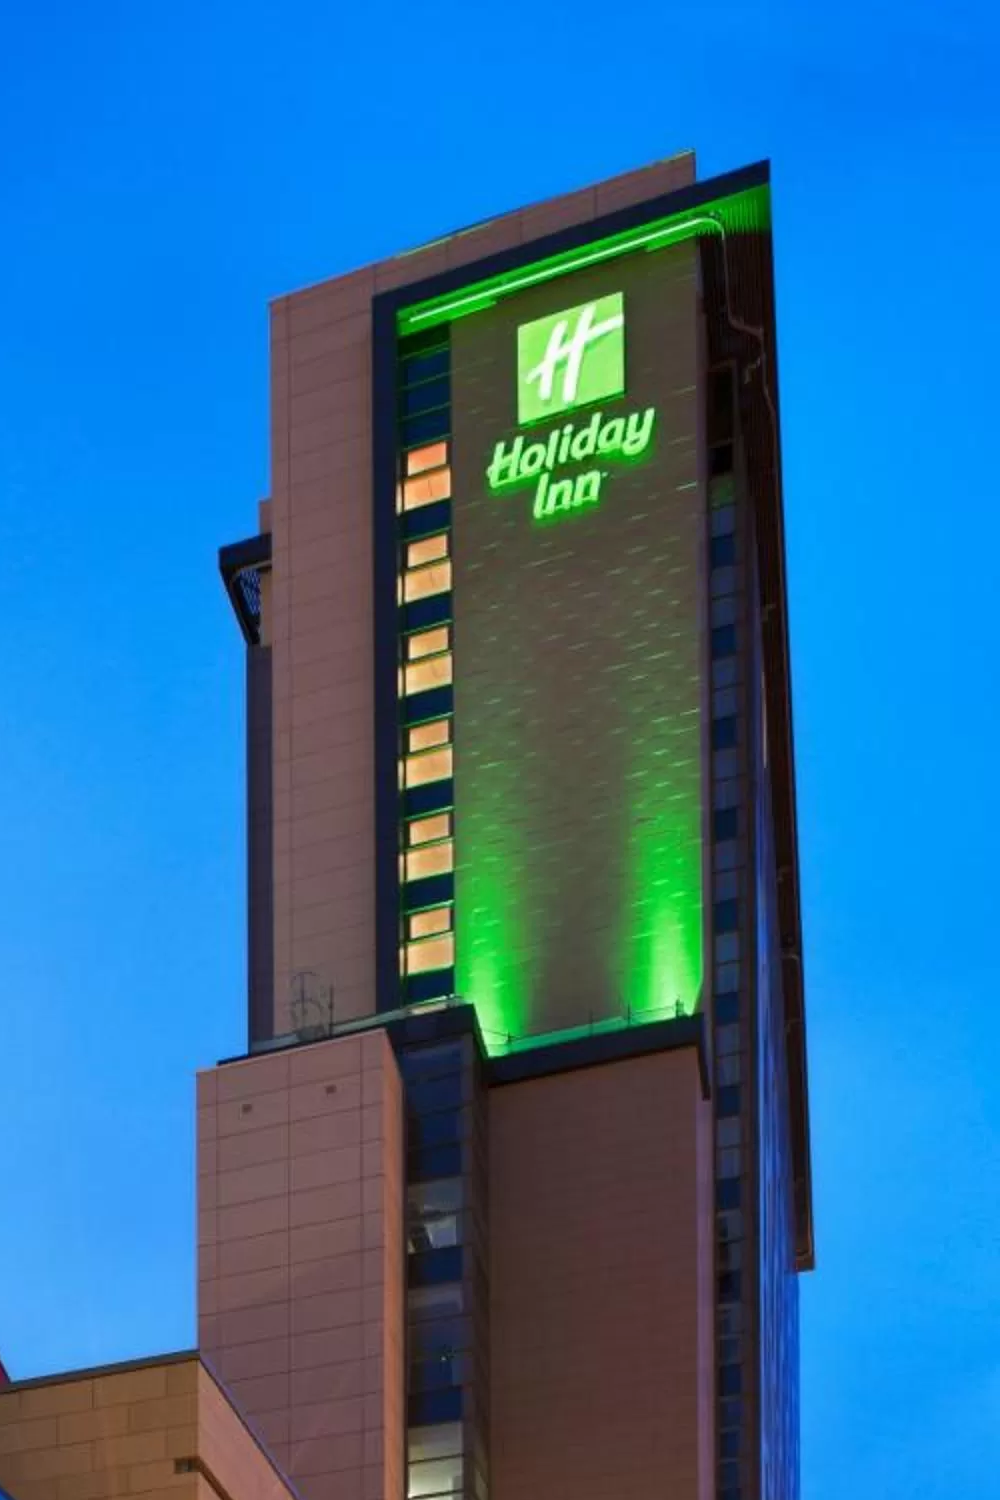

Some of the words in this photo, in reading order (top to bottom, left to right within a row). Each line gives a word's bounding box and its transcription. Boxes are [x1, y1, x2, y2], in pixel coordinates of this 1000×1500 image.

[525, 302, 624, 403] H
[486, 407, 656, 488] Holiday
[533, 469, 602, 519] Inn
